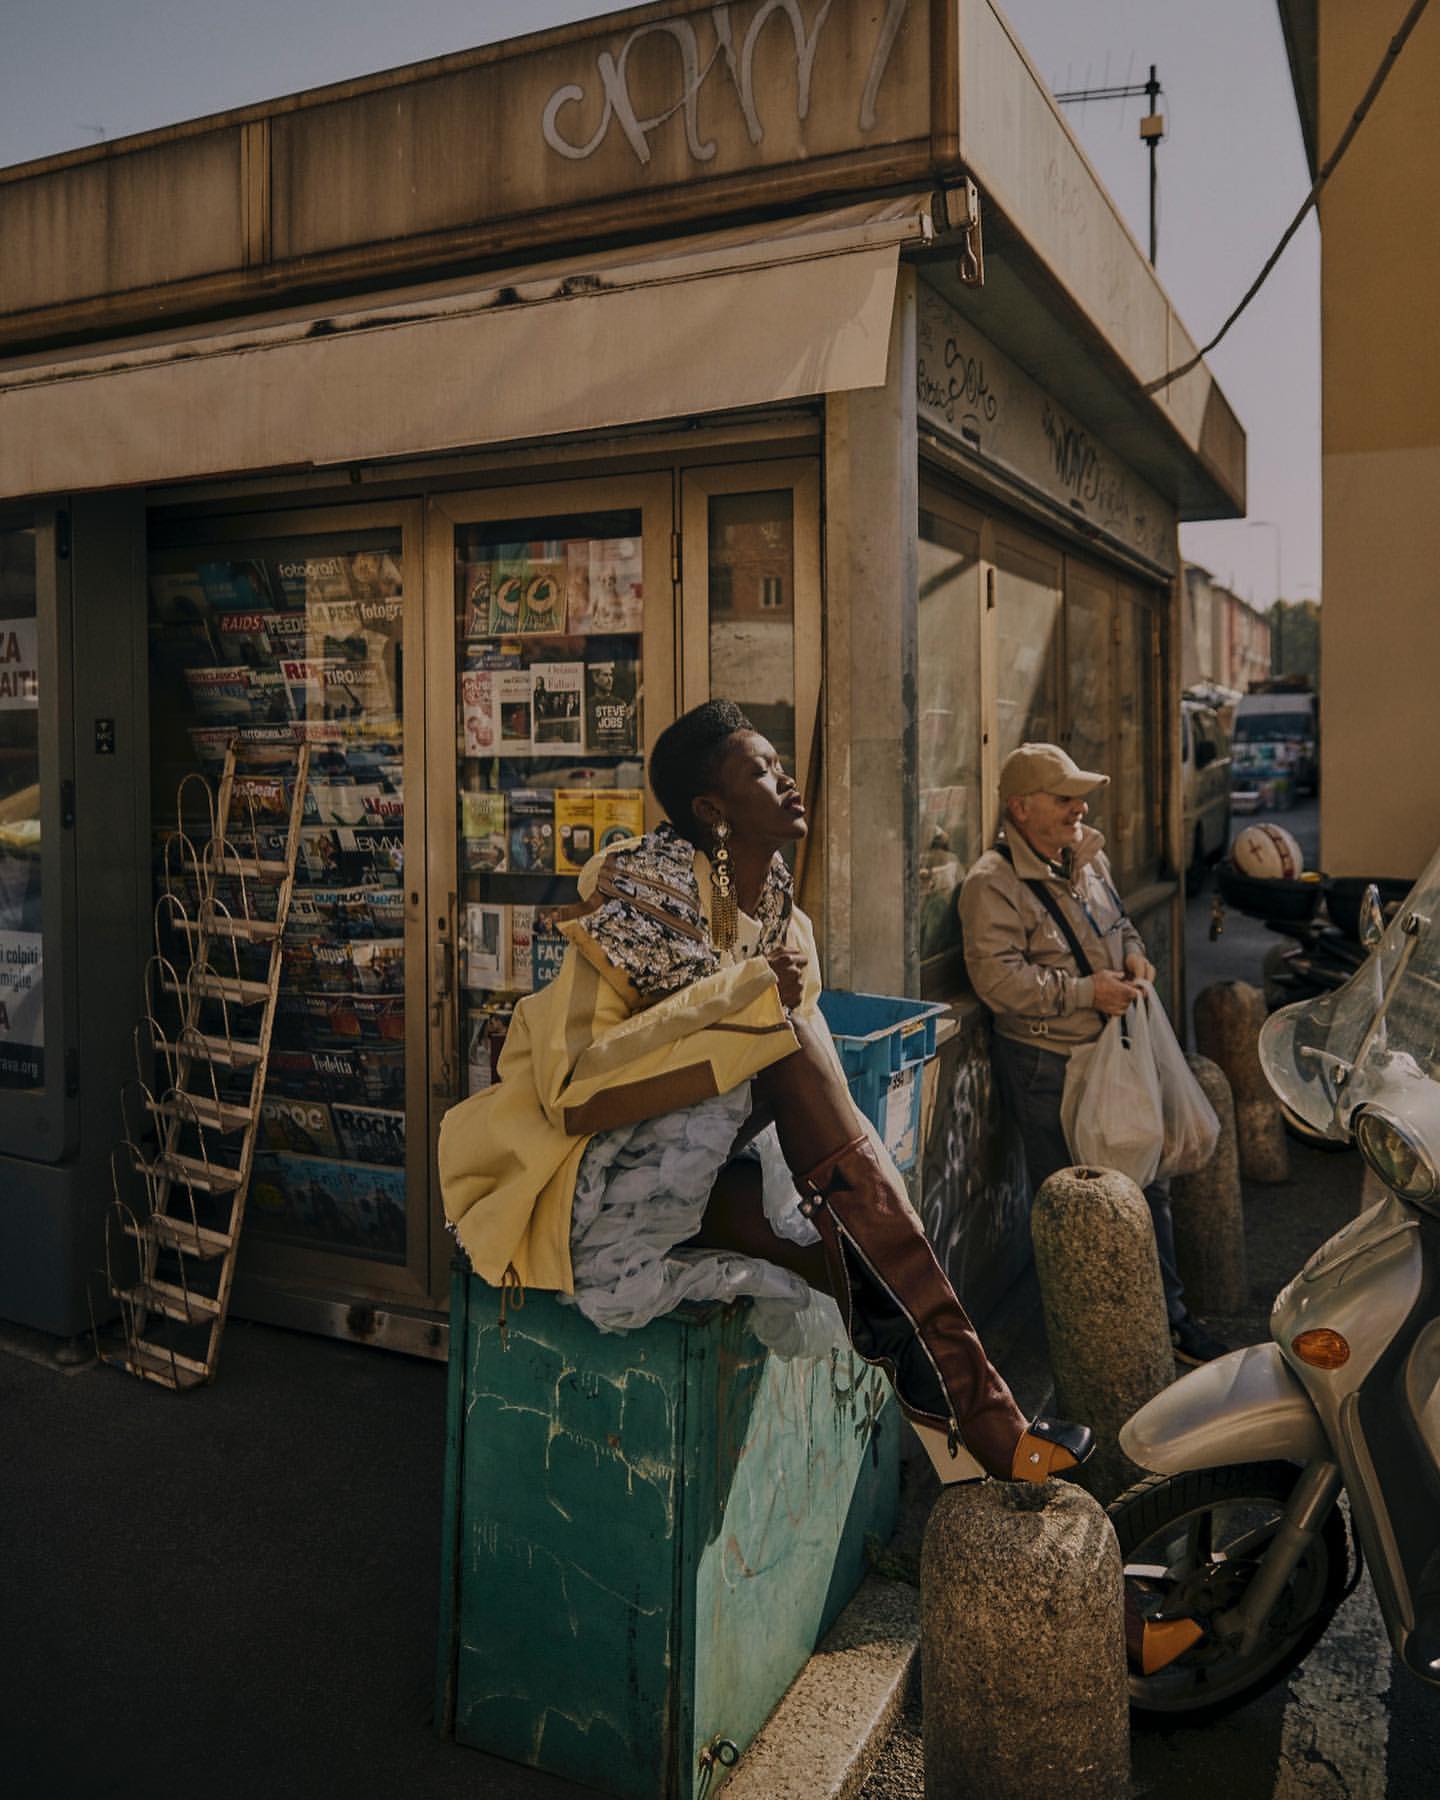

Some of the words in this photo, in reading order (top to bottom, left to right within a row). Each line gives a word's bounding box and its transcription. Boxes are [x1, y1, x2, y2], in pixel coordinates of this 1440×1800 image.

[596, 705, 625, 718] STEVE
[598, 717, 623, 729] JOBS
[7, 944, 38, 968] colpiti
[341, 1111, 403, 1137] ROCK
